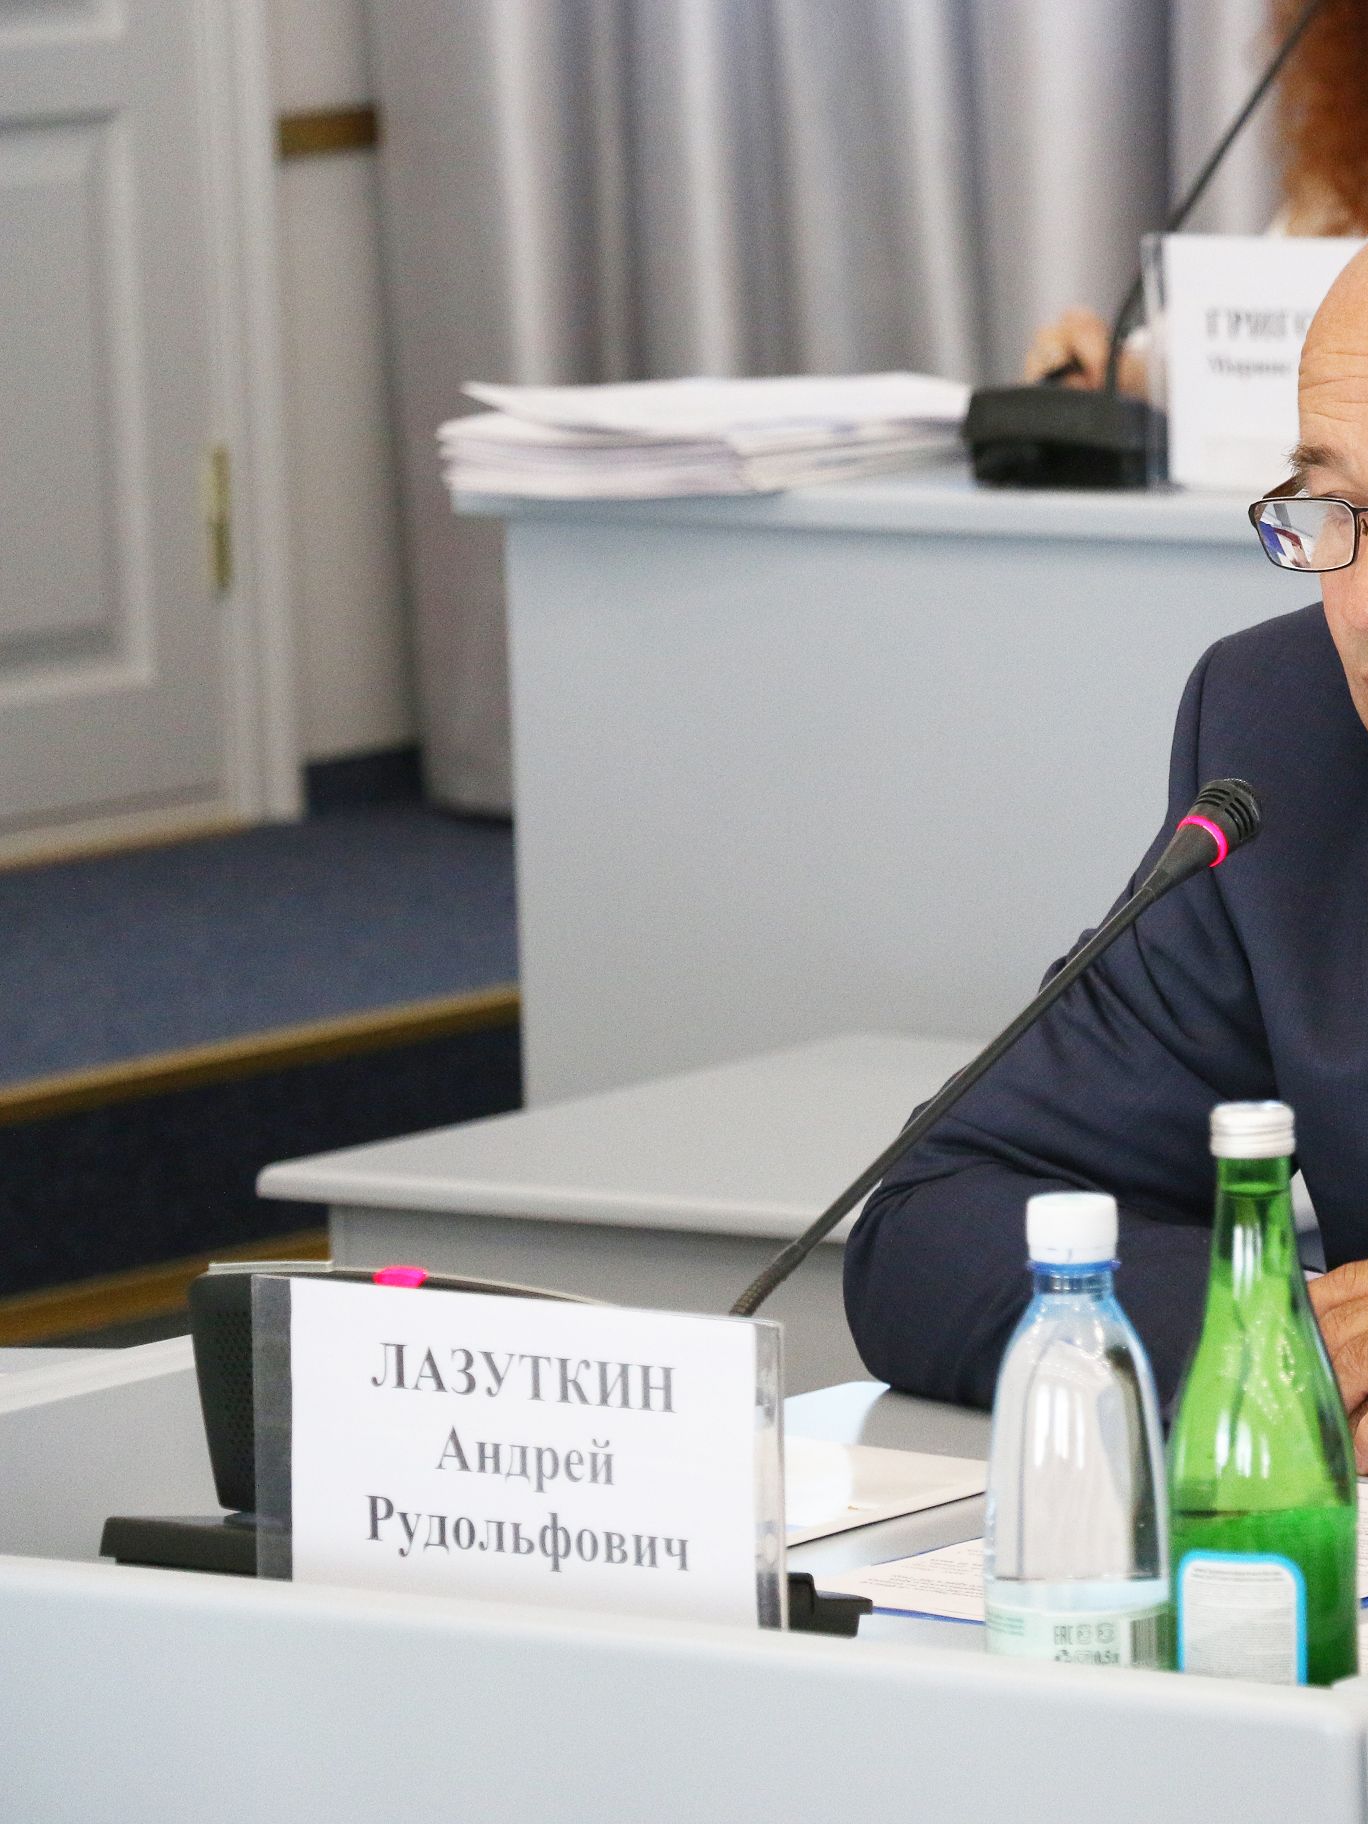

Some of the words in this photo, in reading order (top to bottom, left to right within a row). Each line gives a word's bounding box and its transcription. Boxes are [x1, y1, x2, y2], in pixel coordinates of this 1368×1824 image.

[371, 1342, 677, 1413] ЛАЗУТКИН
[434, 1425, 616, 1494] Андрей
[365, 1495, 690, 1573] Рудольфович
